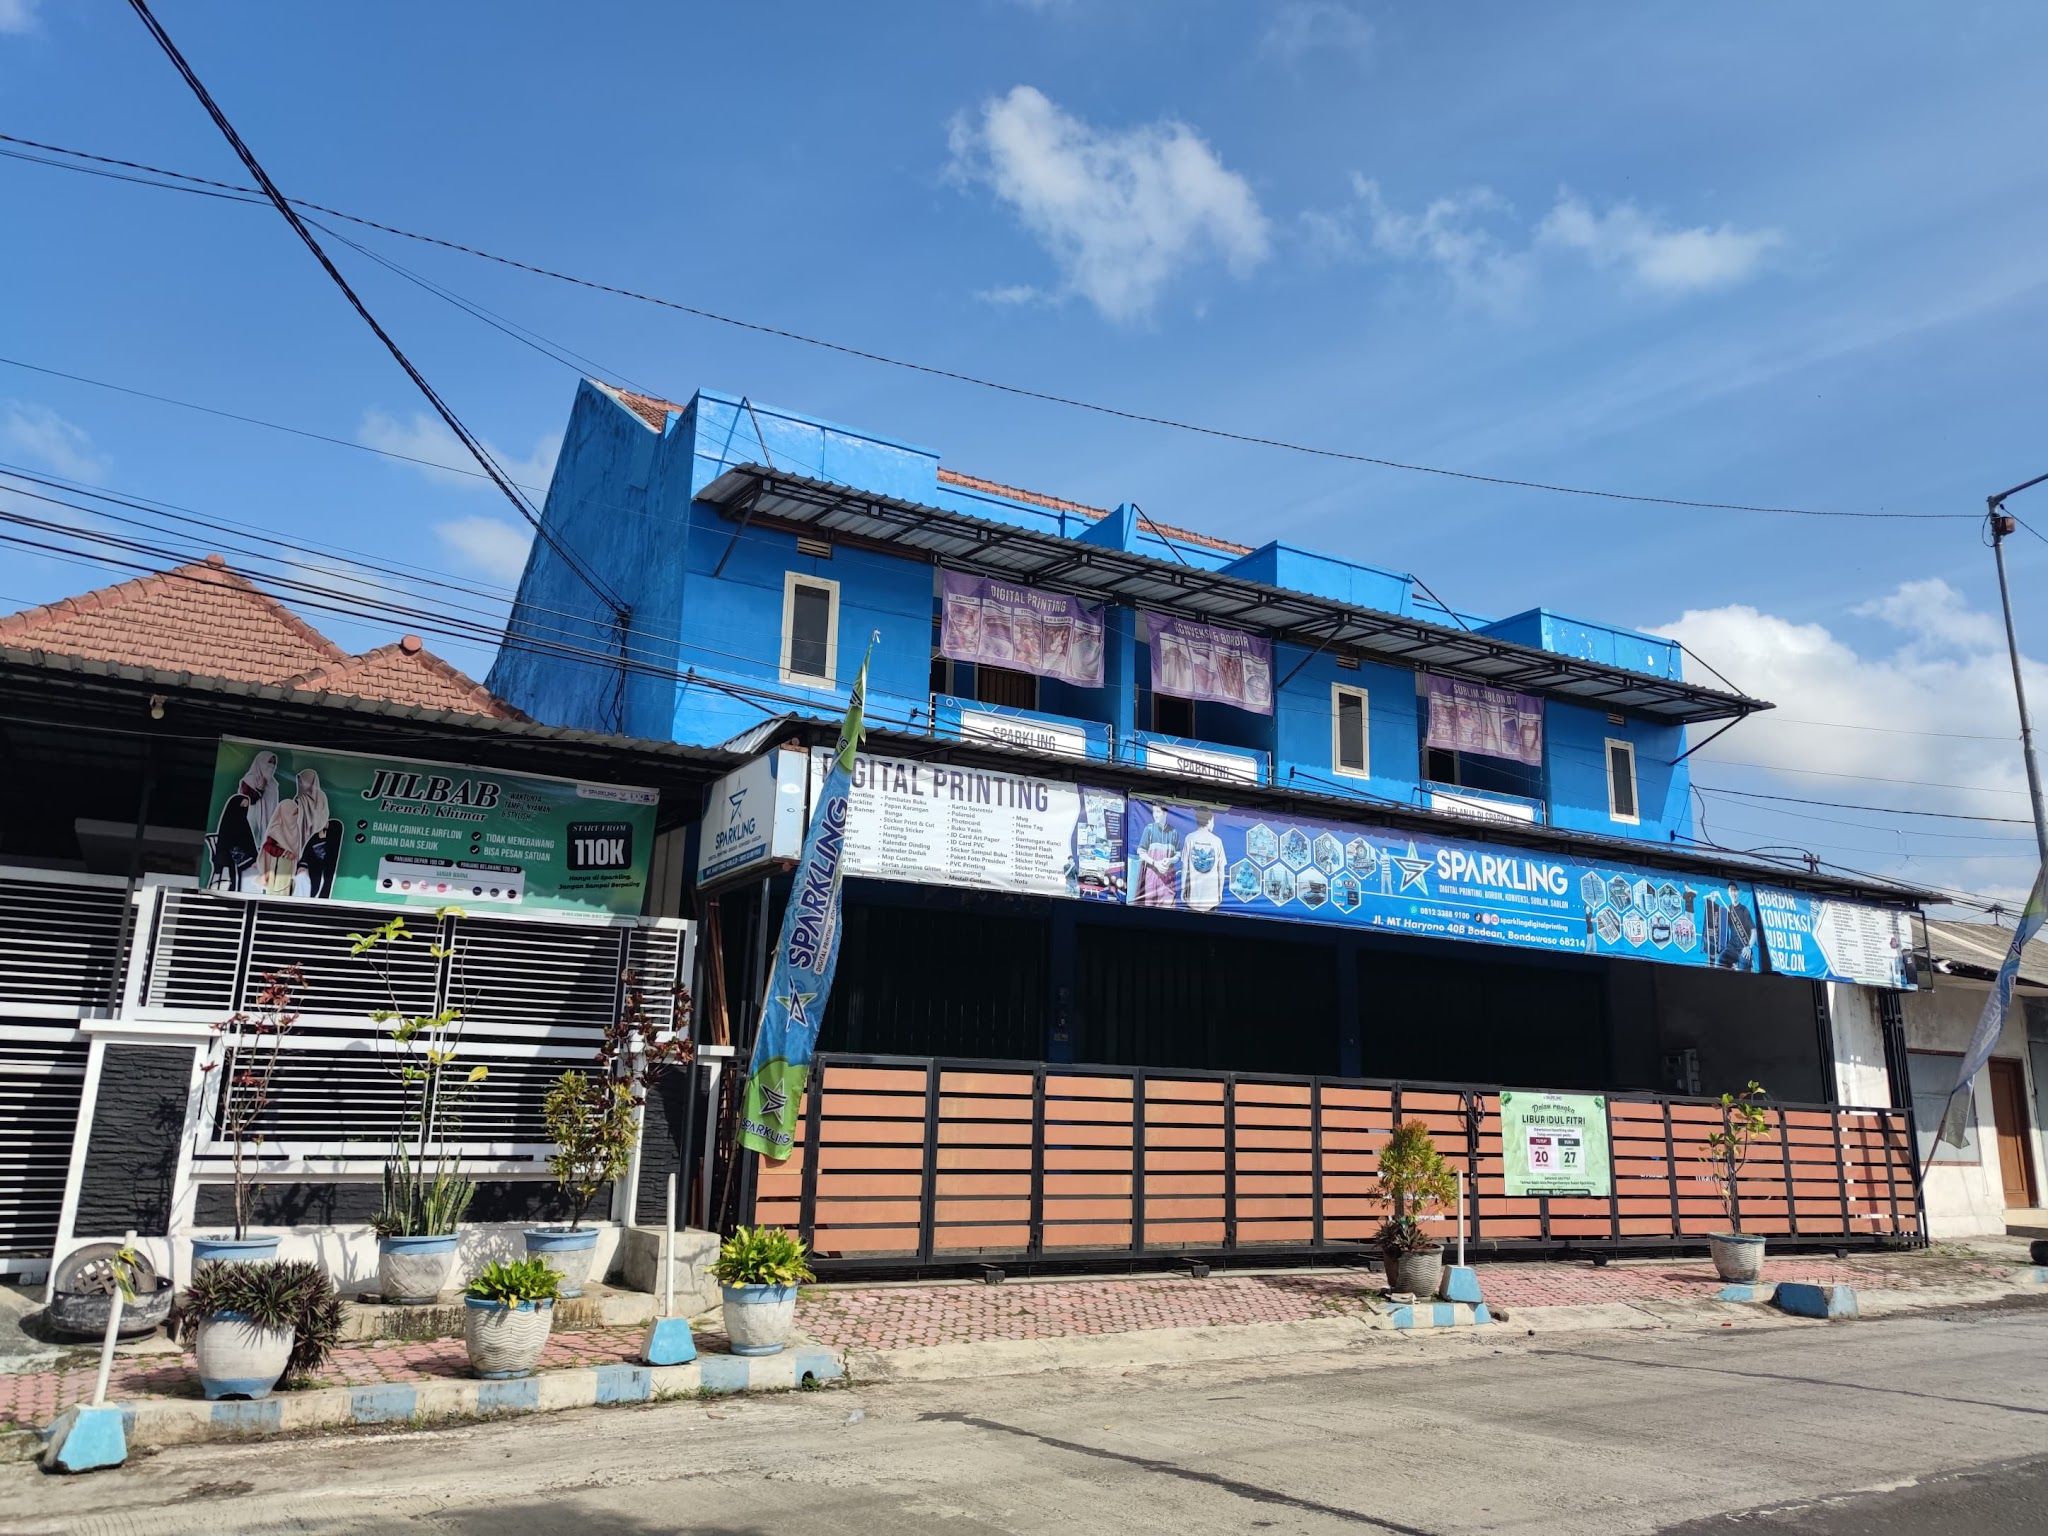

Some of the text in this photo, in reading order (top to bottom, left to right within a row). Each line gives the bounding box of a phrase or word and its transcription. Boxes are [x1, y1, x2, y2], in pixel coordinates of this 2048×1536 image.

[990, 585, 1066, 612] DIGITAL PRINTING
[1220, 633, 1249, 647] BORDIR
[993, 727, 1056, 751] SPARKLING
[361, 769, 501, 809] JILBAB
[933, 768, 1048, 812] PRINTING
[884, 795, 911, 804] Pembatas
[379, 799, 488, 822] French Khimar
[854, 806, 875, 814] Banner
[884, 802, 929, 813] Papan Karangan
[884, 810, 902, 818] Bunga
[951, 811, 976, 819] Polaroid
[951, 818, 981, 826] Photocard
[601, 824, 627, 832] FROM
[883, 824, 904, 833] Cutting
[904, 819, 918, 827] Print
[372, 822, 462, 839] BAHAN CRINKLE AIRFLOW
[715, 817, 756, 851] SPARKLING
[882, 832, 907, 840] Hangtag
[371, 835, 439, 851] RINGAN DAN SEJUK
[486, 833, 555, 848] TIDAK MENERAWANG
[882, 839, 931, 850] Kalender Dinding
[483, 846, 550, 861] BISA PESAN SATUAN
[574, 839, 625, 866] 110K
[882, 846, 907, 854] Kalender
[971, 848, 992, 857] Sampul
[881, 854, 894, 862] Map
[1015, 856, 1034, 864] Sticker
[963, 862, 986, 870] Printing
[1436, 849, 1569, 896] SPARKLING
[610, 881, 641, 889] Berpaling
[789, 796, 848, 969] SPARKLING
[1439, 884, 1458, 895] DIGITAL
[1551, 899, 1569, 909] SABLON
[1756, 889, 1797, 911] BORDIR
[1420, 907, 1436, 915] 0812
[1454, 911, 1470, 920] 9100
[1500, 917, 1569, 932] sparklingdigitalprinting
[1760, 908, 1811, 933] KONVEKSI
[1372, 915, 1586, 948] Jl. MT Haryono 40B Badean, Bondowoso 68214
[816, 923, 834, 972] DIGITAL PRINTING
[1522, 1114, 1585, 1125] LIBUR IDUL FITRI
[741, 1117, 790, 1144] SPARKLING
[1535, 1150, 1576, 1164] 20 27
